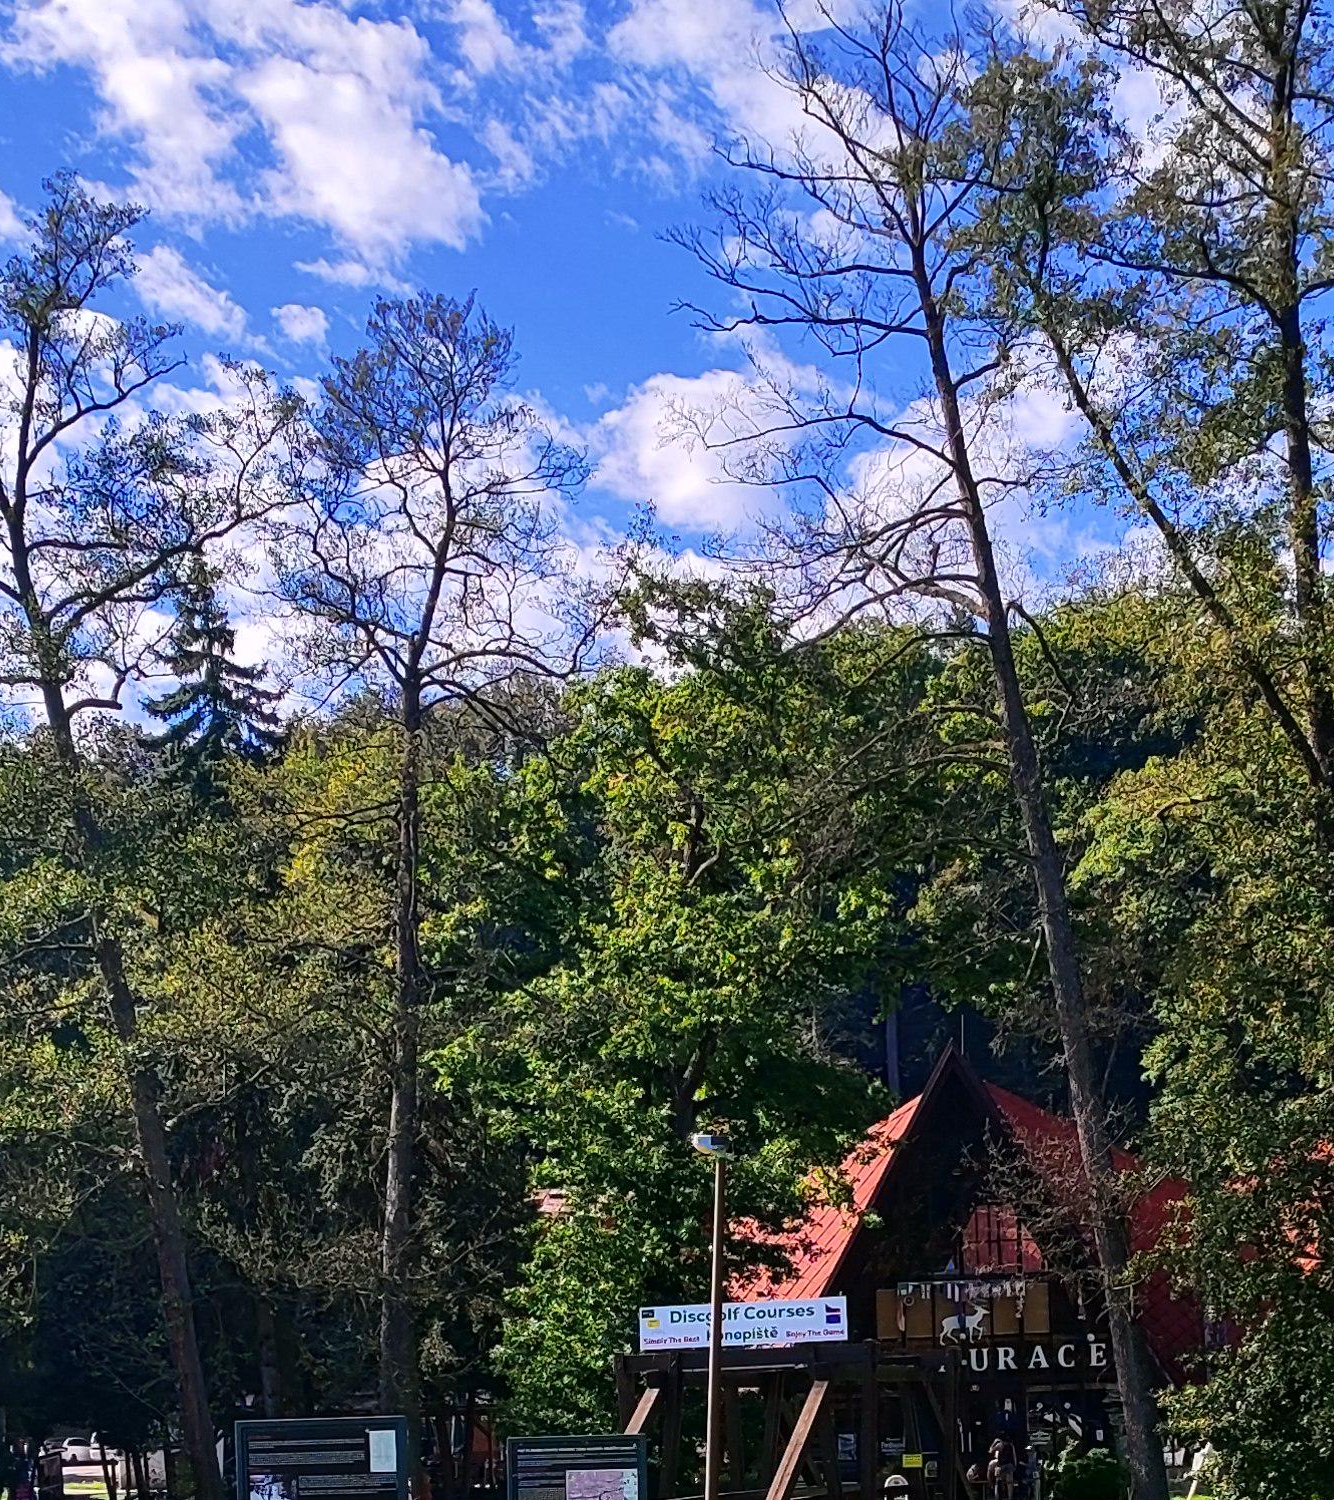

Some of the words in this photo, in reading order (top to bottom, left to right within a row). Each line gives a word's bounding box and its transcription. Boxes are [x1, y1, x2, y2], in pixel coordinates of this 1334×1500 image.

[744, 1306, 815, 1320] Courses
[707, 1326, 778, 1343] nopiště
[785, 1331, 806, 1339] Enjoy
[823, 1328, 845, 1336] Game
[643, 1338, 667, 1346] Simply
[668, 1336, 681, 1344] The
